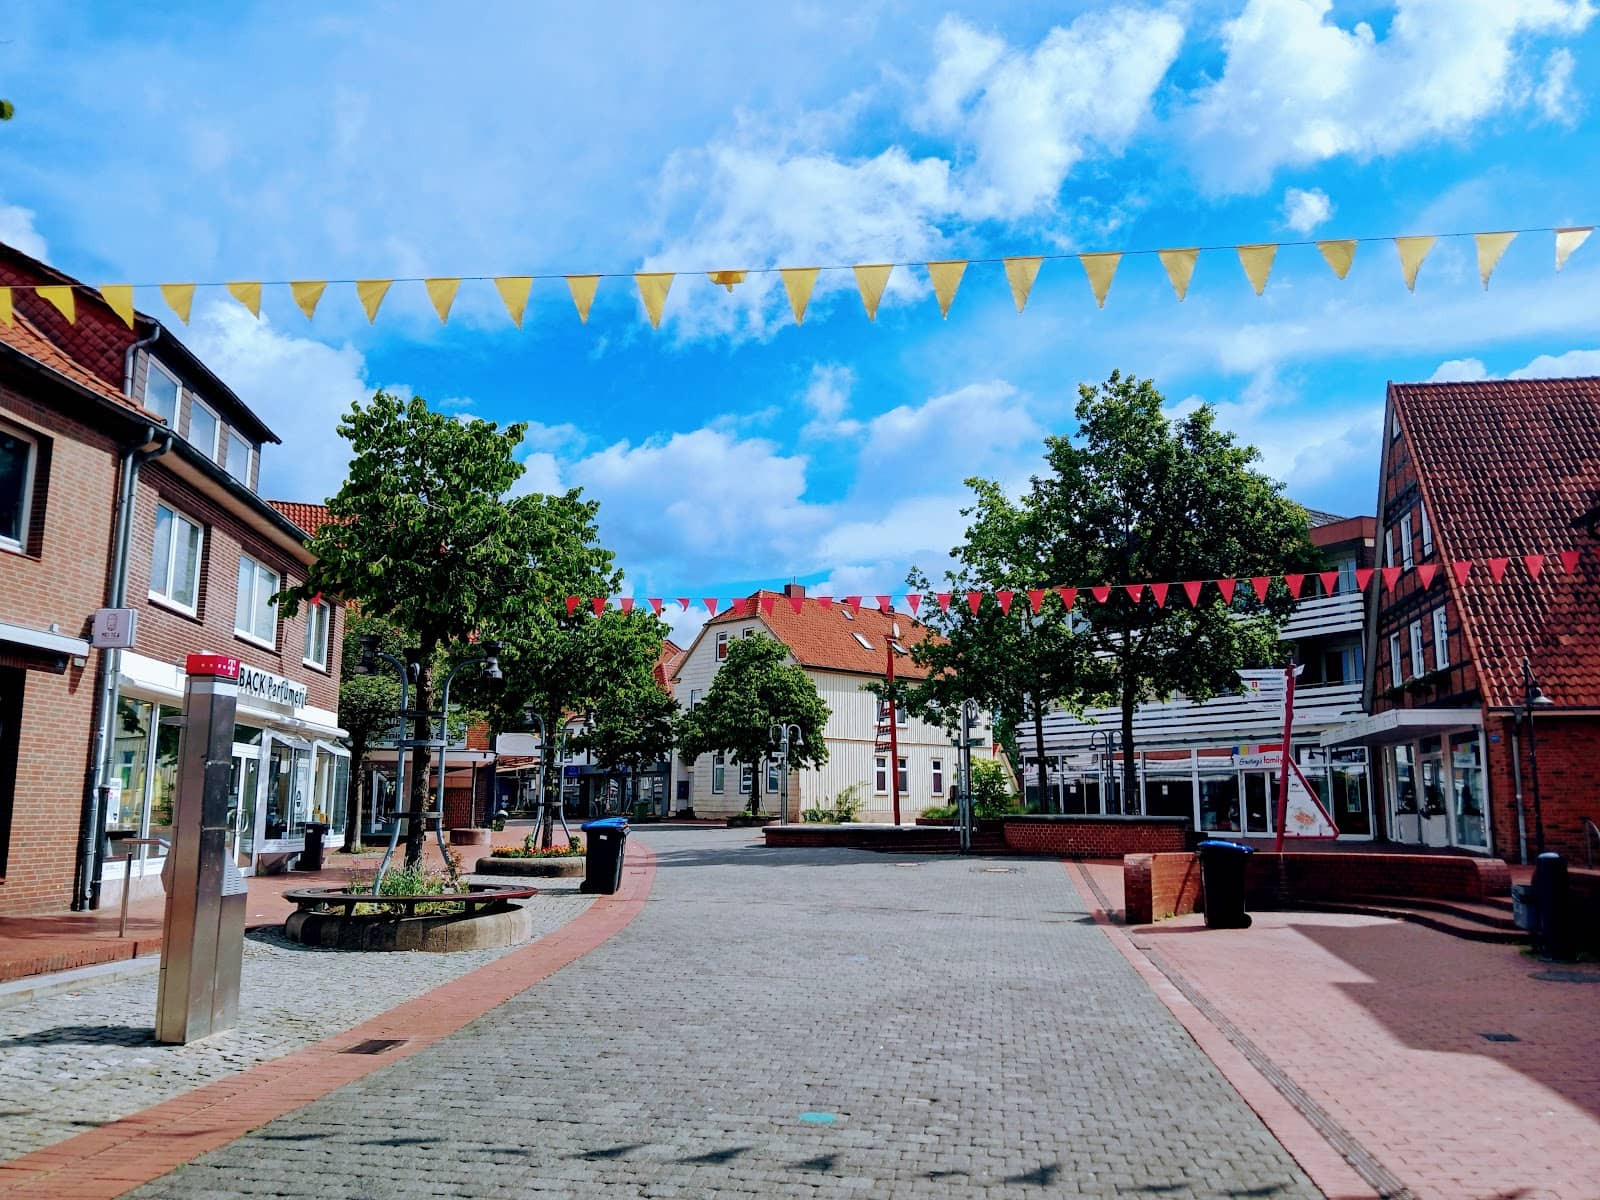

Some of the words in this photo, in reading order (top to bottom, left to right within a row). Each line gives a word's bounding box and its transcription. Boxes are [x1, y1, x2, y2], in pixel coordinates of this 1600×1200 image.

[228, 659, 236, 676] T
[239, 667, 266, 694] BACK
[268, 676, 308, 706] Parfümerie
